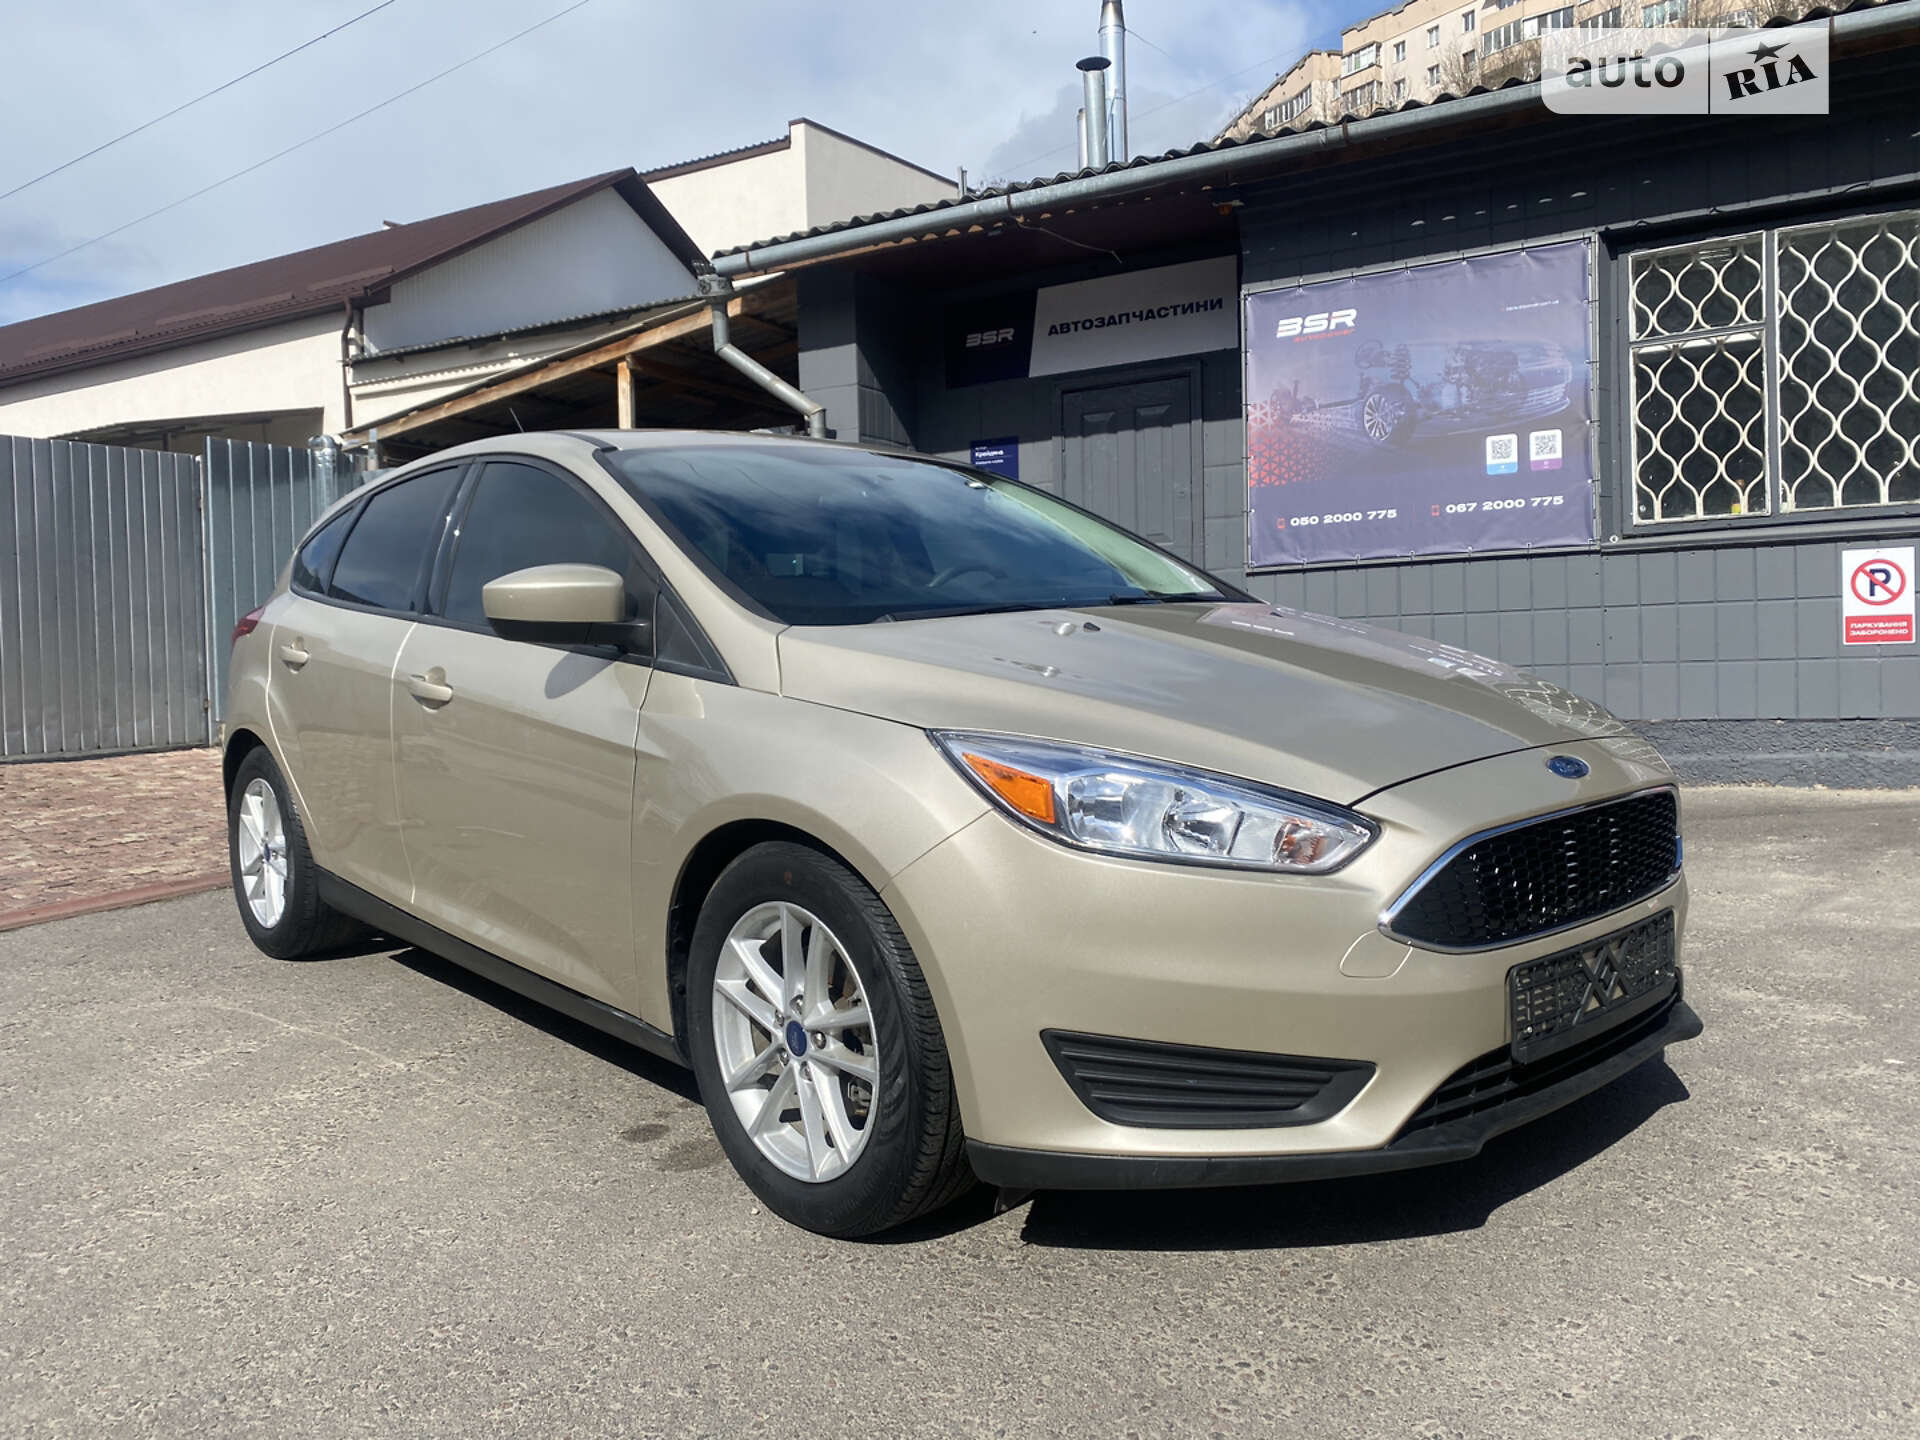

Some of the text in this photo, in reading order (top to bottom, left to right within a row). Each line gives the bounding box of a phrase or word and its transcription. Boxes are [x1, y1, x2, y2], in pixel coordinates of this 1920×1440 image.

[1047, 297, 1224, 337] АВТОЗАПЧАСТИНИ
[1276, 308, 1357, 338] BSR
[965, 328, 1015, 348] BSR
[1445, 495, 1563, 514] 067 2000 775
[1290, 509, 1397, 526] 050 2000 775
